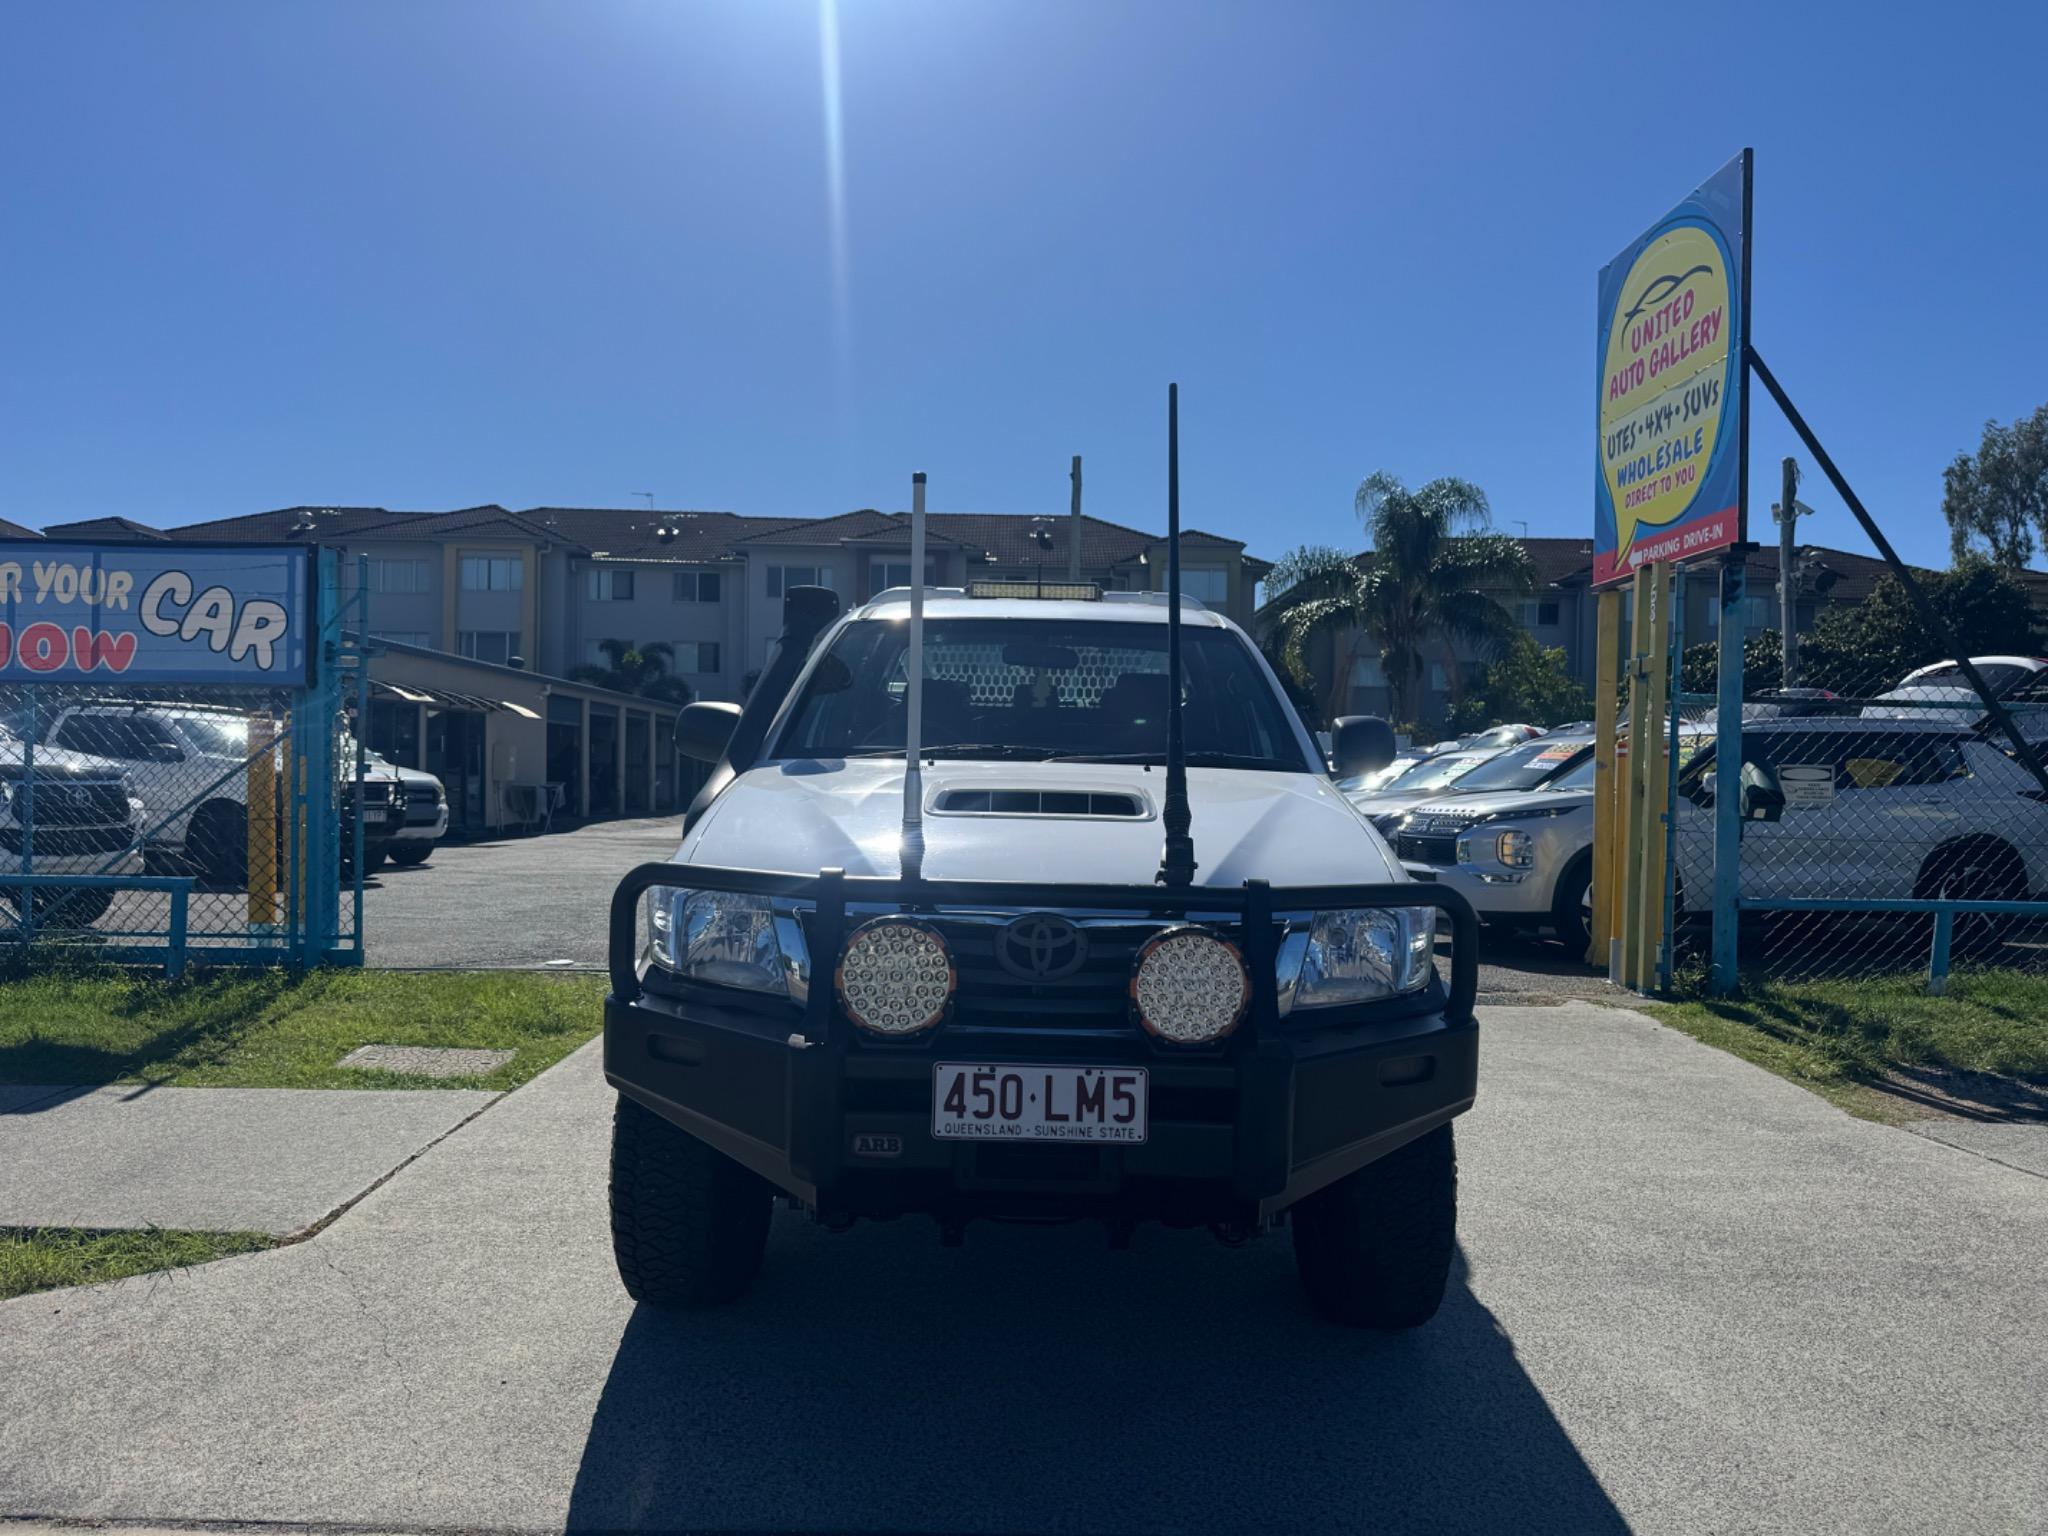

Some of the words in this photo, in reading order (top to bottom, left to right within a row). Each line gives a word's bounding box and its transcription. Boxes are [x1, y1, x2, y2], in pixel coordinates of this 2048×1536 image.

[1631, 288, 1695, 353] UNITED
[1609, 357, 1645, 402] AUTO
[1649, 304, 1722, 378] GALLERY
[1607, 420, 1636, 460] UTES
[1617, 427, 1703, 488] WHOLESALE
[1625, 482, 1657, 509] DIRECT
[1659, 475, 1672, 493] TO
[1675, 464, 1695, 488] YOU
[1642, 538, 1680, 562] PARKING
[1683, 522, 1723, 550] DRIVE-IN
[33, 560, 134, 611] YOUR
[139, 570, 289, 672] CAR
[857, 1137, 900, 1153] ARB
[944, 1123, 1022, 1136] QUEENSLAND
[1034, 1125, 1093, 1138] SUNSHINE
[1099, 1127, 1135, 1139] STATE
